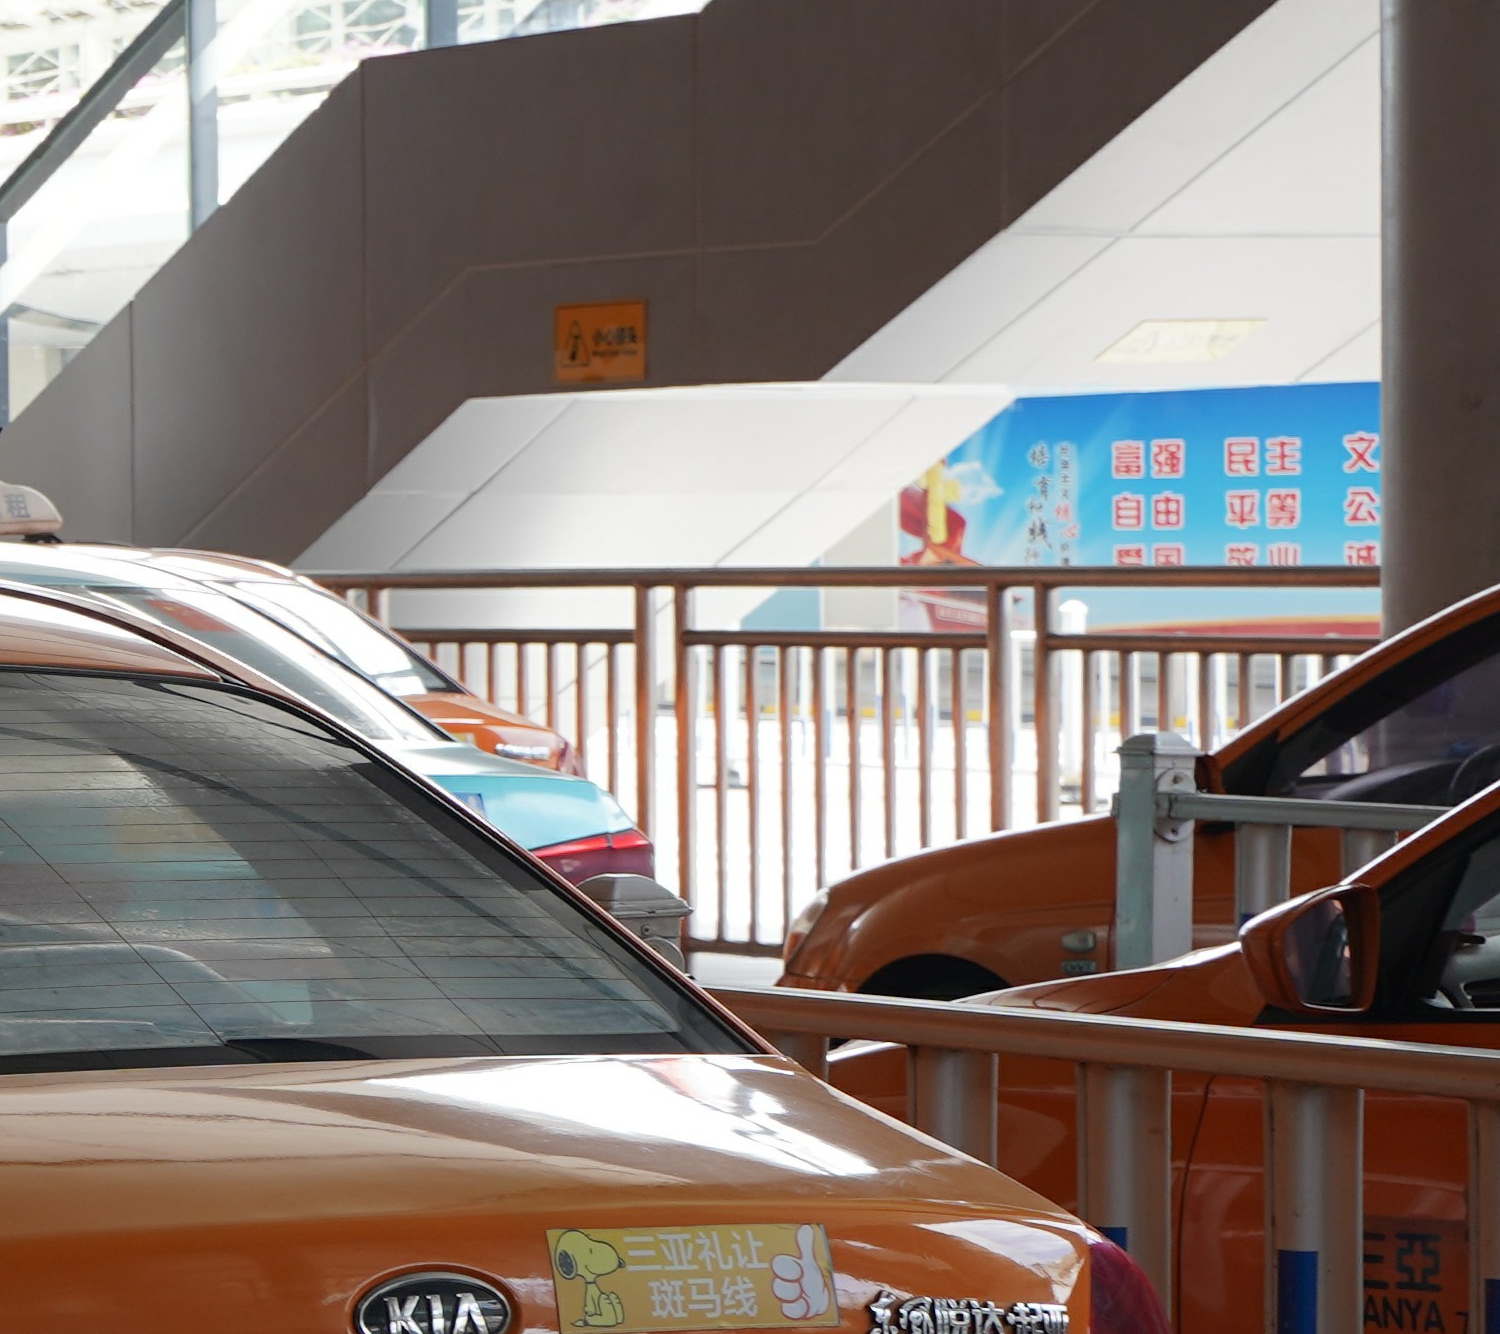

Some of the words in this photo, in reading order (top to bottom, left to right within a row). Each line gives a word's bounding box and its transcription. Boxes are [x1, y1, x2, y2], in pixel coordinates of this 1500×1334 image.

[1112, 441, 1184, 475] 富强
[1225, 439, 1300, 474] 民主
[1344, 434, 1377, 471] 文
[1113, 495, 1184, 528] 自由
[1227, 493, 1298, 525] 平等
[1346, 490, 1377, 522] 公
[622, 1230, 770, 1272] 三亚礼让
[647, 1276, 758, 1319] 斑马线
